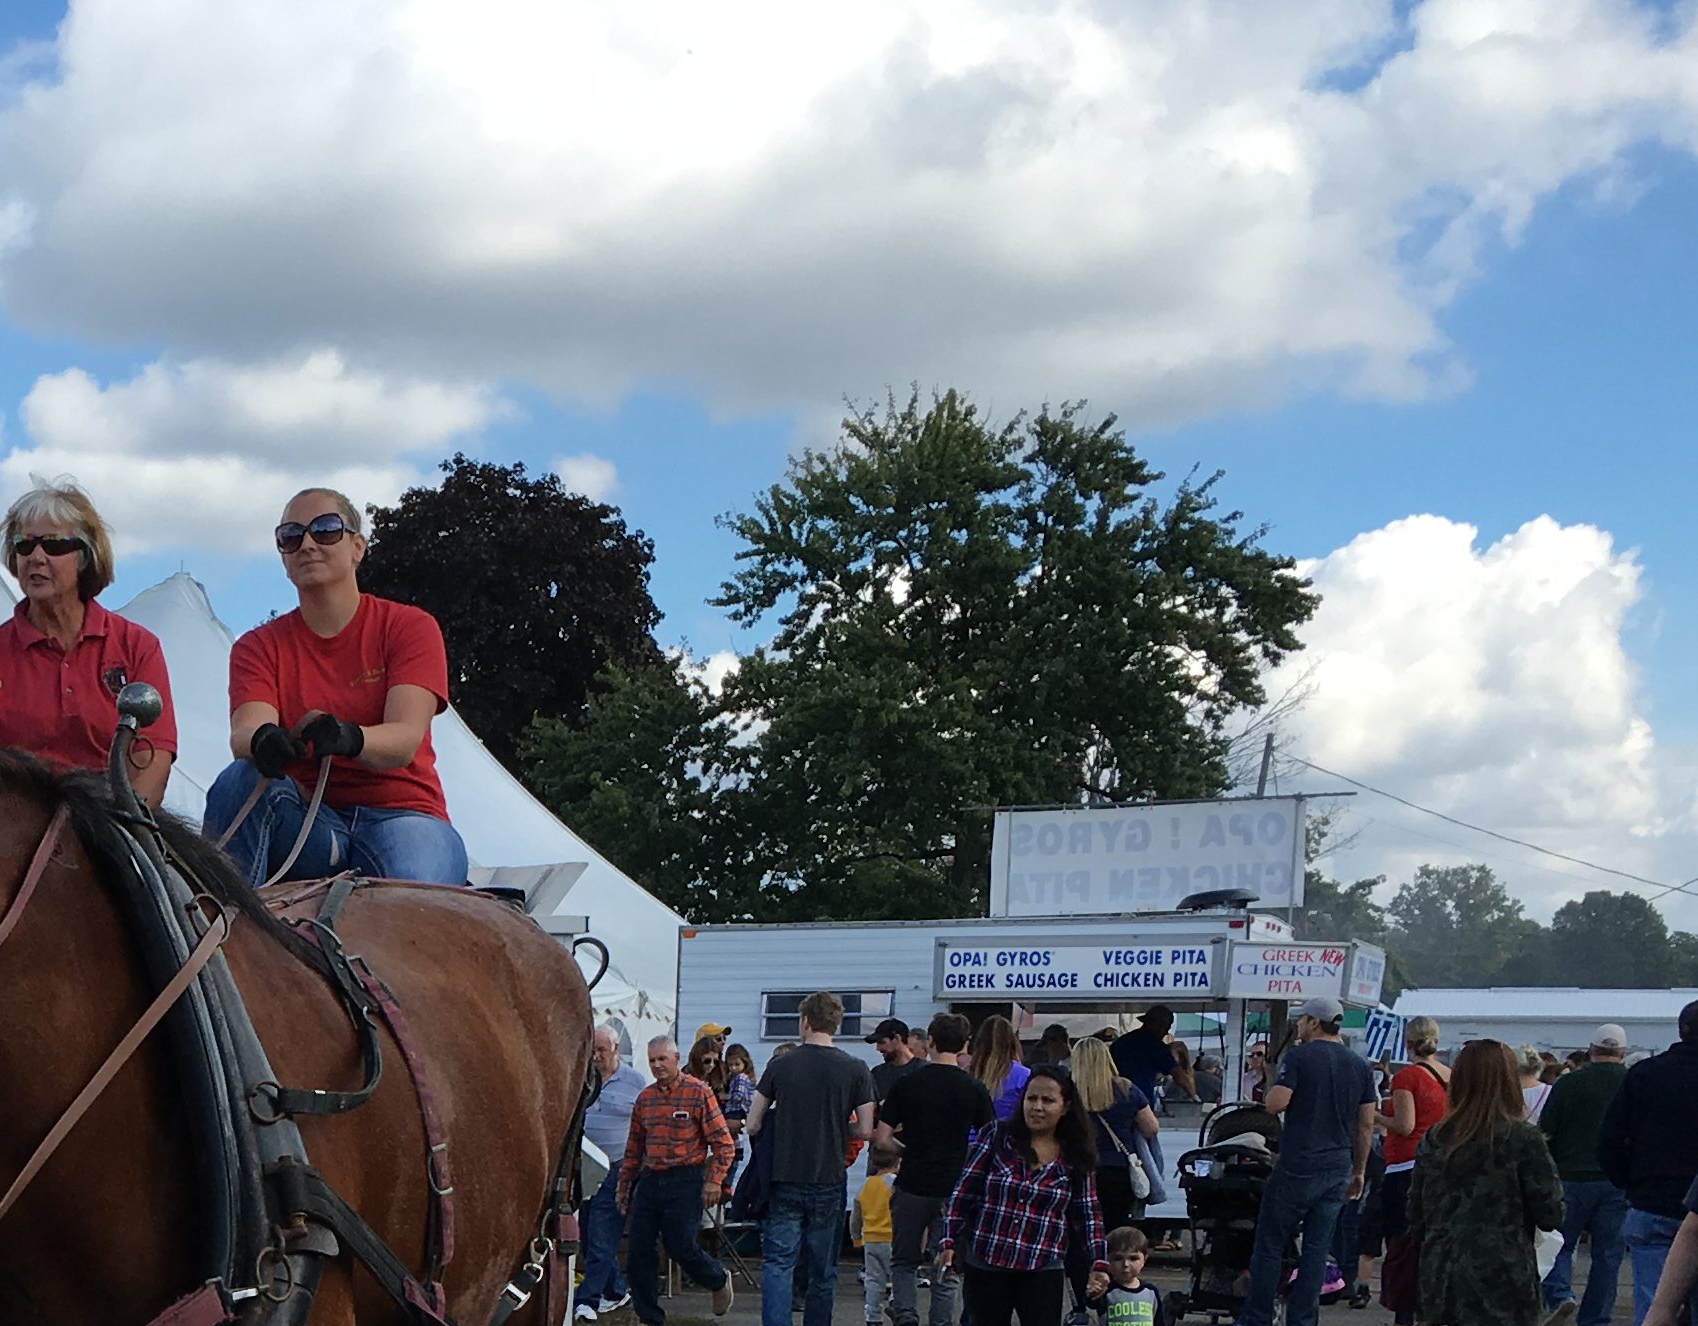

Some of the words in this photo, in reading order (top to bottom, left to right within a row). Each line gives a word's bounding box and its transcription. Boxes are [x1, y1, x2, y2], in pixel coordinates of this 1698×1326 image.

[949, 951, 988, 967] OPA!
[996, 950, 1052, 967] GYROS
[1102, 949, 1163, 966] VEGGIE
[1171, 949, 1207, 965] PITA
[1262, 949, 1316, 963] GREEK
[1319, 948, 1346, 968] NEW
[1237, 963, 1337, 978] CHICKEN
[945, 973, 996, 989] GREEK
[1005, 972, 1078, 989] SAUSAGE
[1093, 972, 1165, 988] CHICKEN
[1173, 971, 1209, 987] PITA
[1268, 980, 1303, 993] PITA
